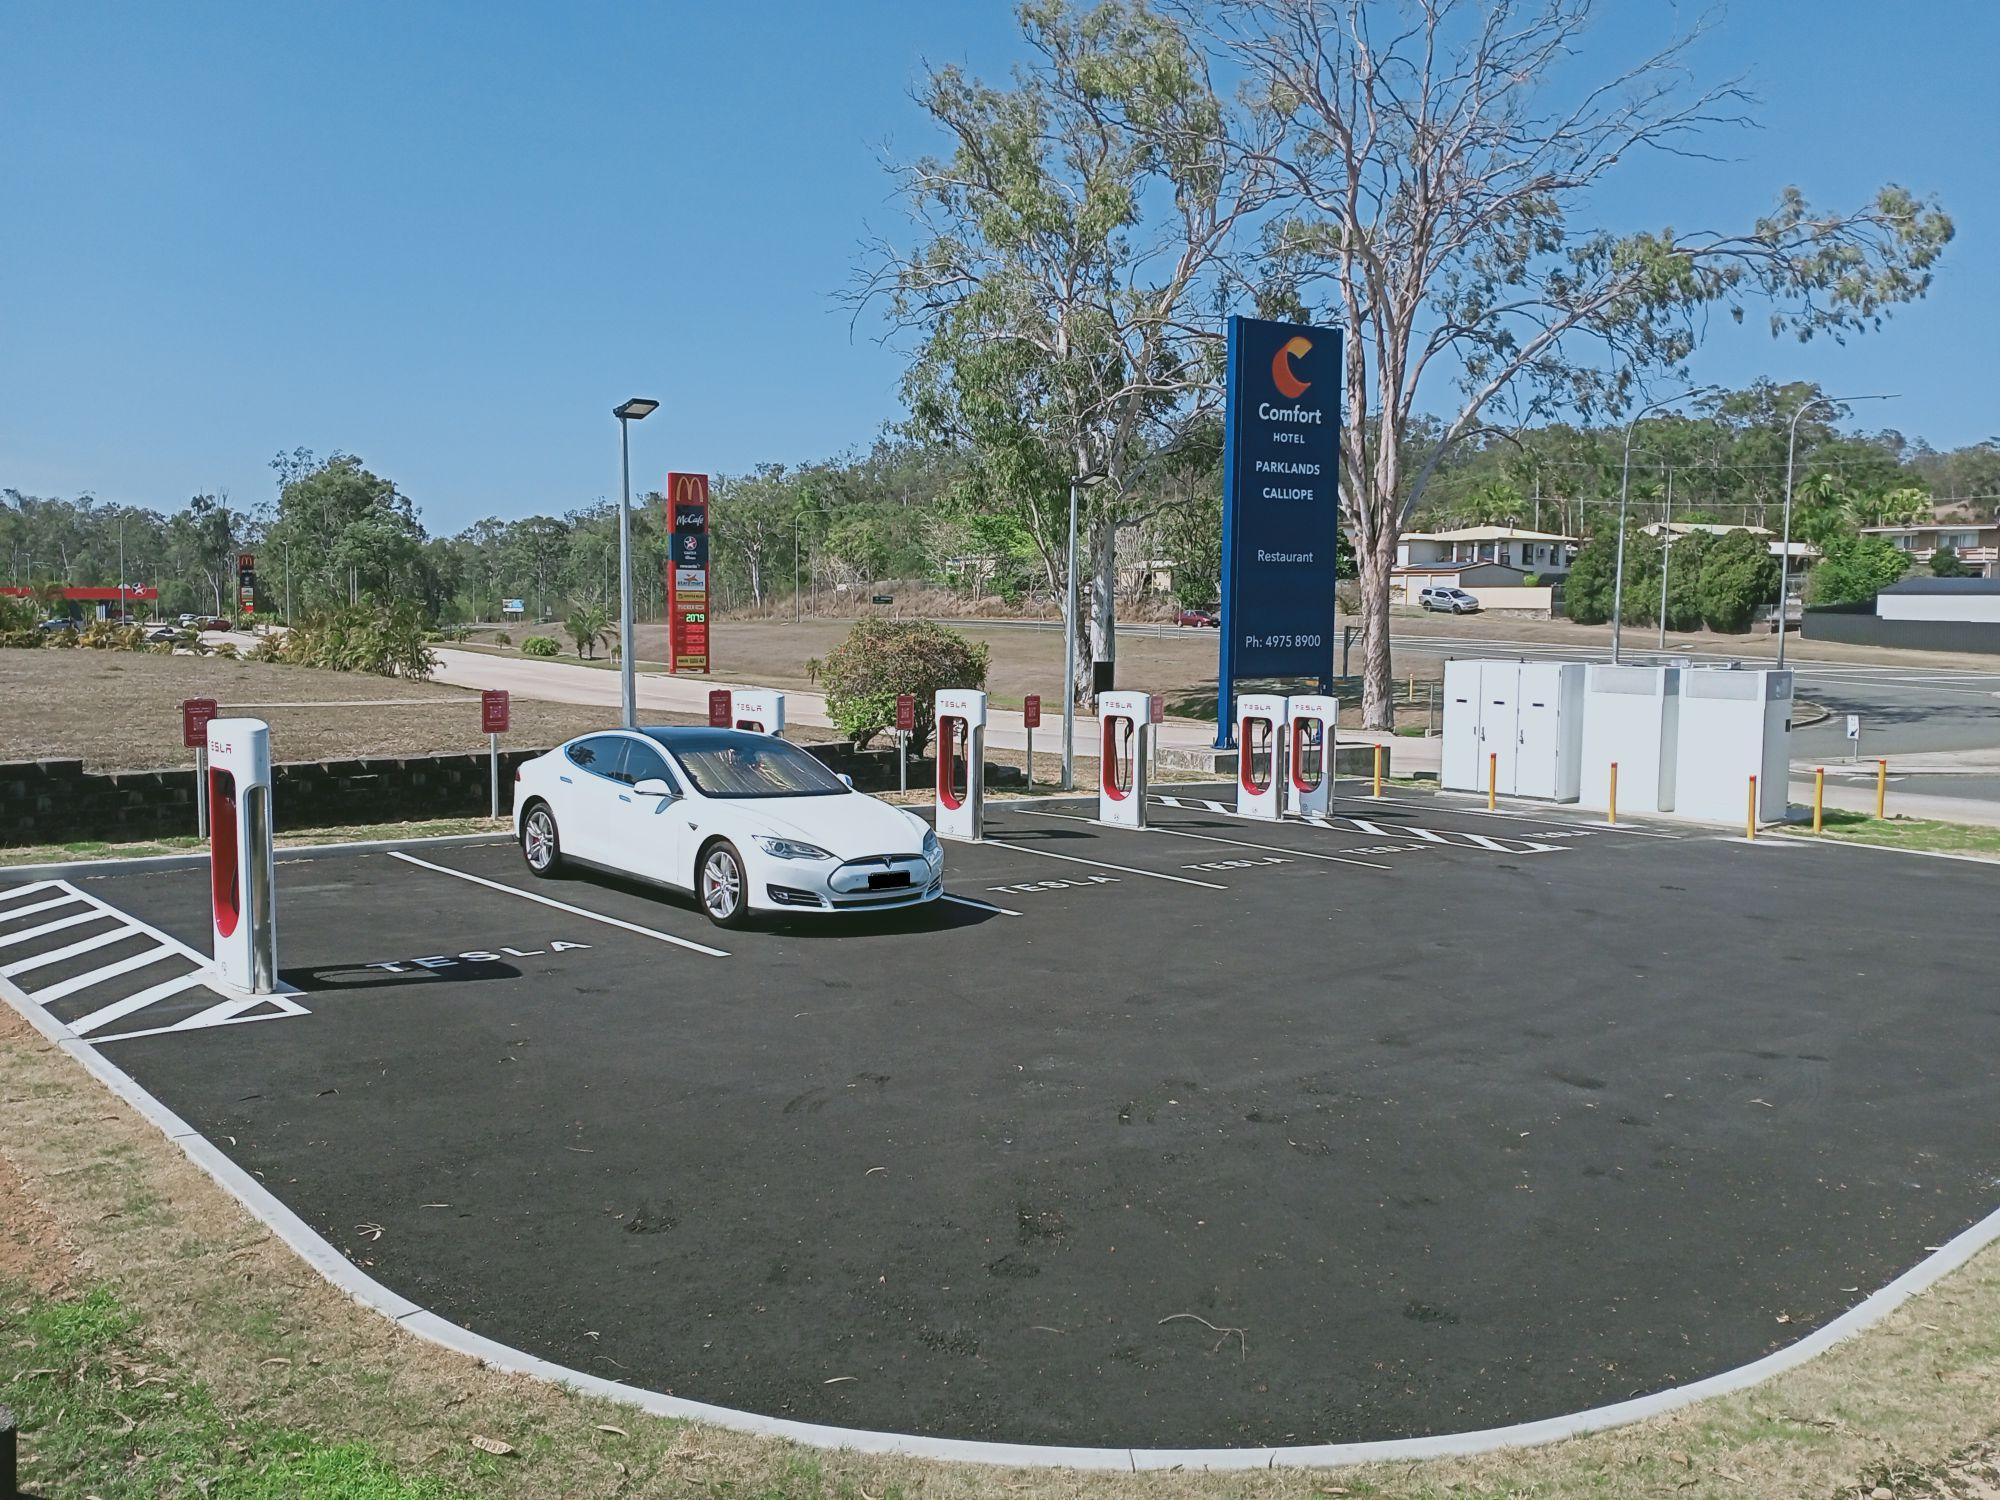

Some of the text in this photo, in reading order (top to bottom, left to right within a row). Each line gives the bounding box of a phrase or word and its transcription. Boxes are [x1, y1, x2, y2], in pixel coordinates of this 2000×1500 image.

[1258, 402, 1322, 424] Comfort
[1273, 432, 1305, 444] HOTEL
[1255, 460, 1320, 475] PARKLANDS
[1262, 487, 1314, 500] CALLIOPE
[676, 513, 704, 526] McCafé
[1257, 550, 1313, 562] Restaurant
[1245, 635, 1321, 648] Ph: 4975 8900
[736, 703, 762, 711] TESLA
[941, 700, 966, 708] TESLA
[1105, 701, 1132, 709] TESLA
[1244, 703, 1271, 711] TESLA
[1181, 855, 1295, 873] TESLA
[986, 872, 1121, 895] TESLA
[365, 940, 593, 973] TESLA
